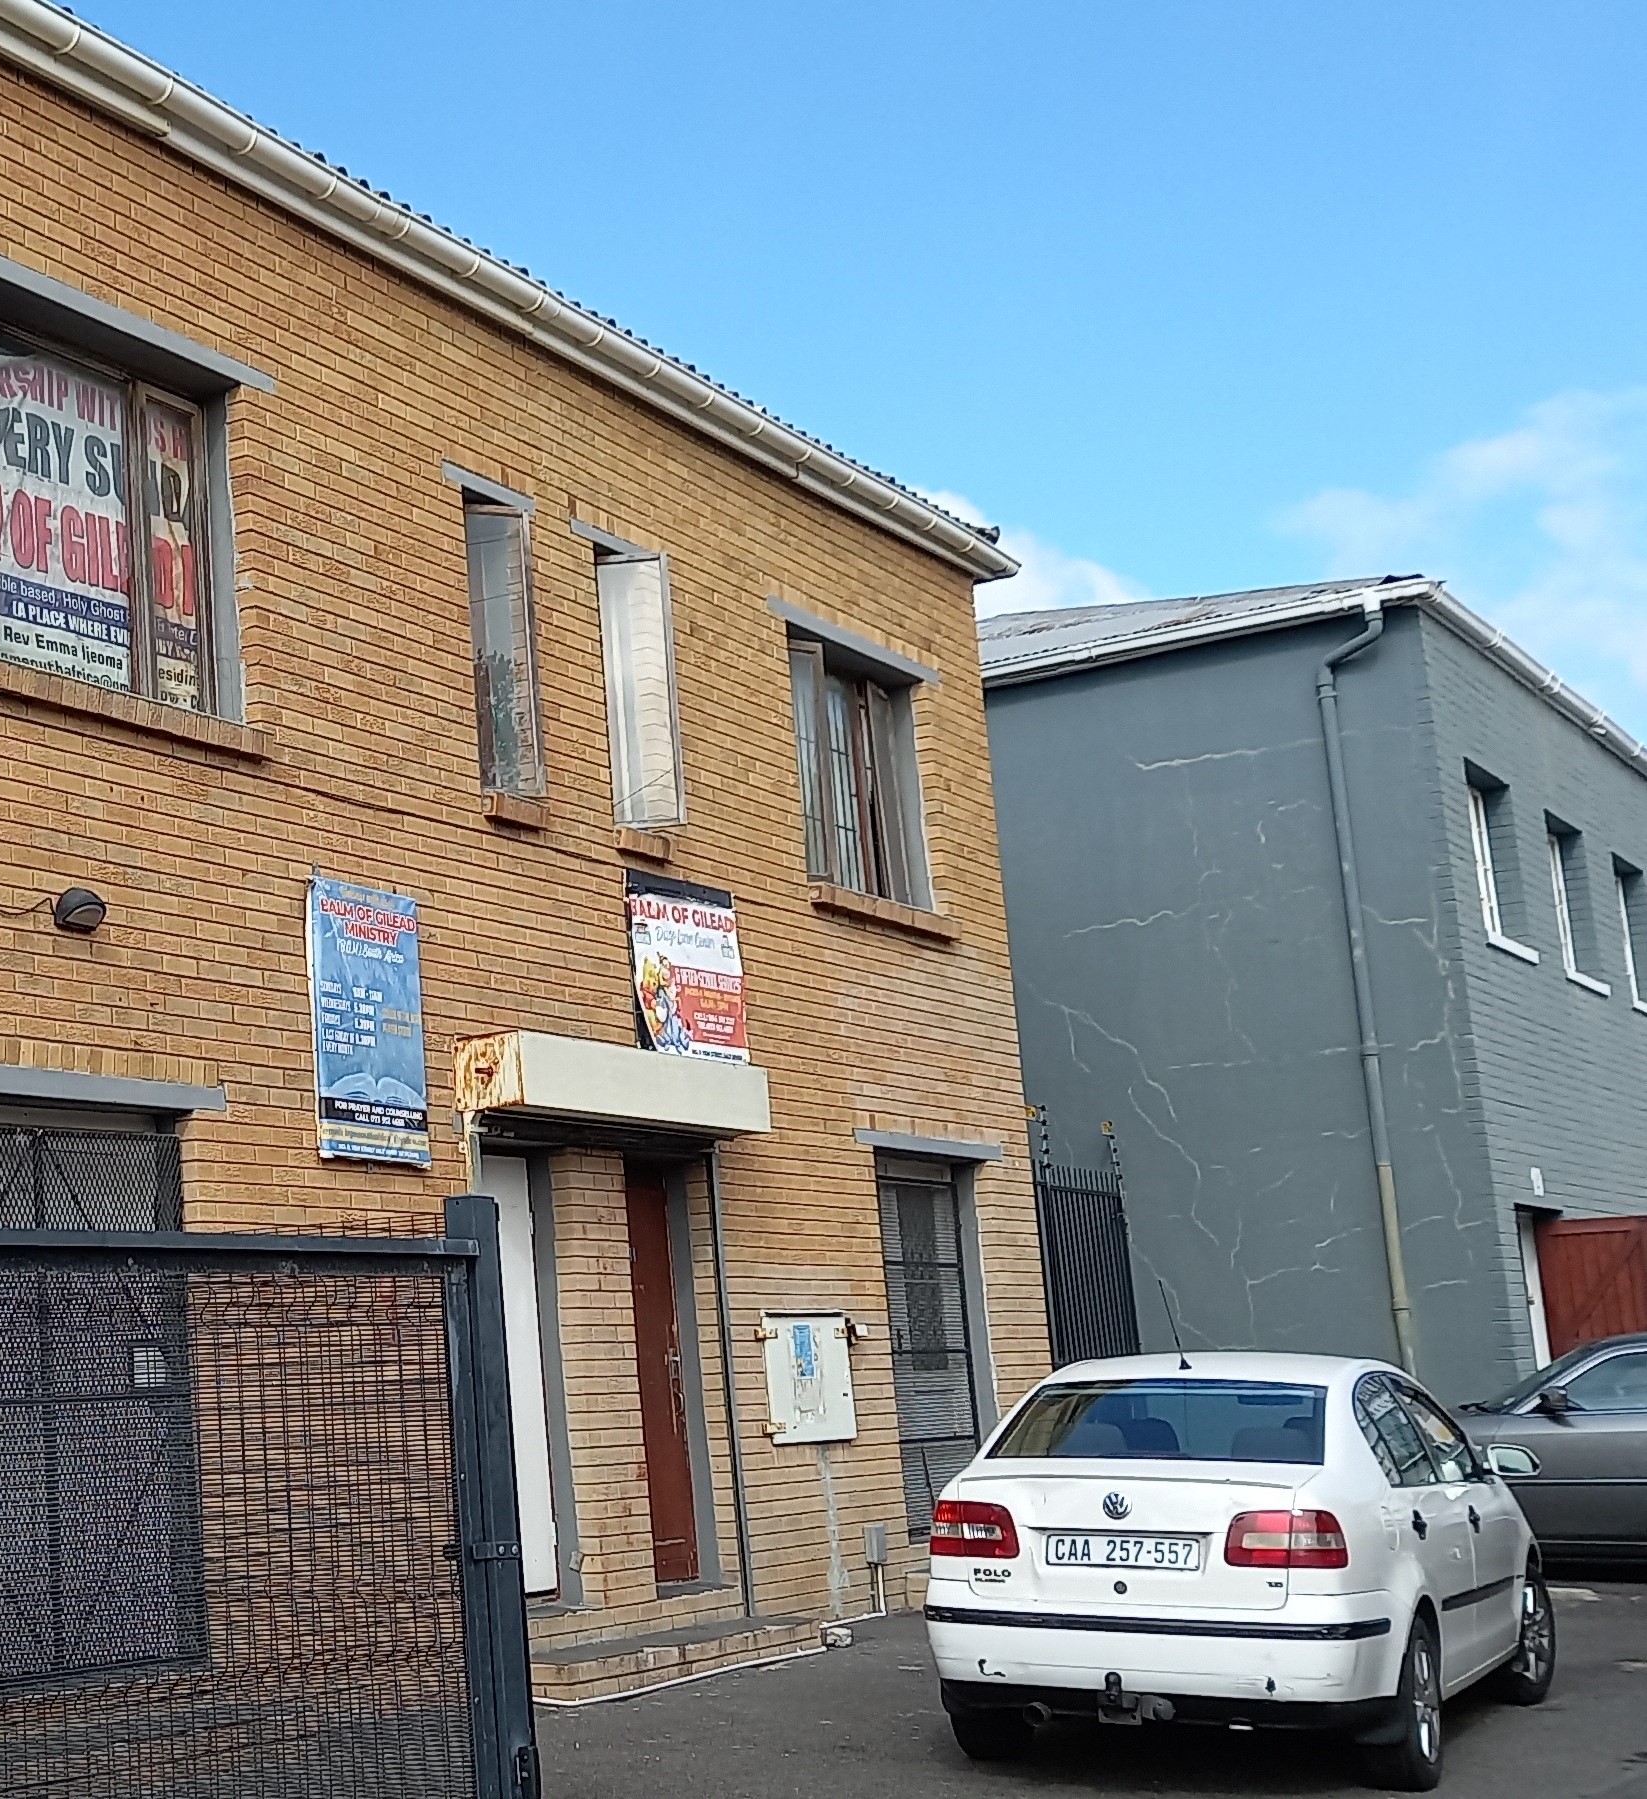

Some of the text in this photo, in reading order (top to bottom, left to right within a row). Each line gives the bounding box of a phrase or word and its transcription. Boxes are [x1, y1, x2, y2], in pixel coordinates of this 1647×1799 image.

[10, 488, 53, 574] OF
[20, 580, 60, 608] based,
[63, 592, 87, 615] Holy
[90, 600, 125, 623] Ghost
[28, 604, 66, 629] PLACE
[68, 614, 108, 640] WHERE
[3, 624, 30, 646] Rev
[35, 633, 78, 657] Emma
[319, 898, 416, 932] BALM OF GILEAD
[671, 905, 689, 924] OF
[691, 909, 735, 933] GILEAD
[344, 920, 398, 946] MINISTRY
[335, 1100, 348, 1111] FOR
[348, 1103, 371, 1116] PRAYER
[1055, 1538, 1194, 1566] CAA 257-557
[973, 1567, 1012, 1578] POLO
